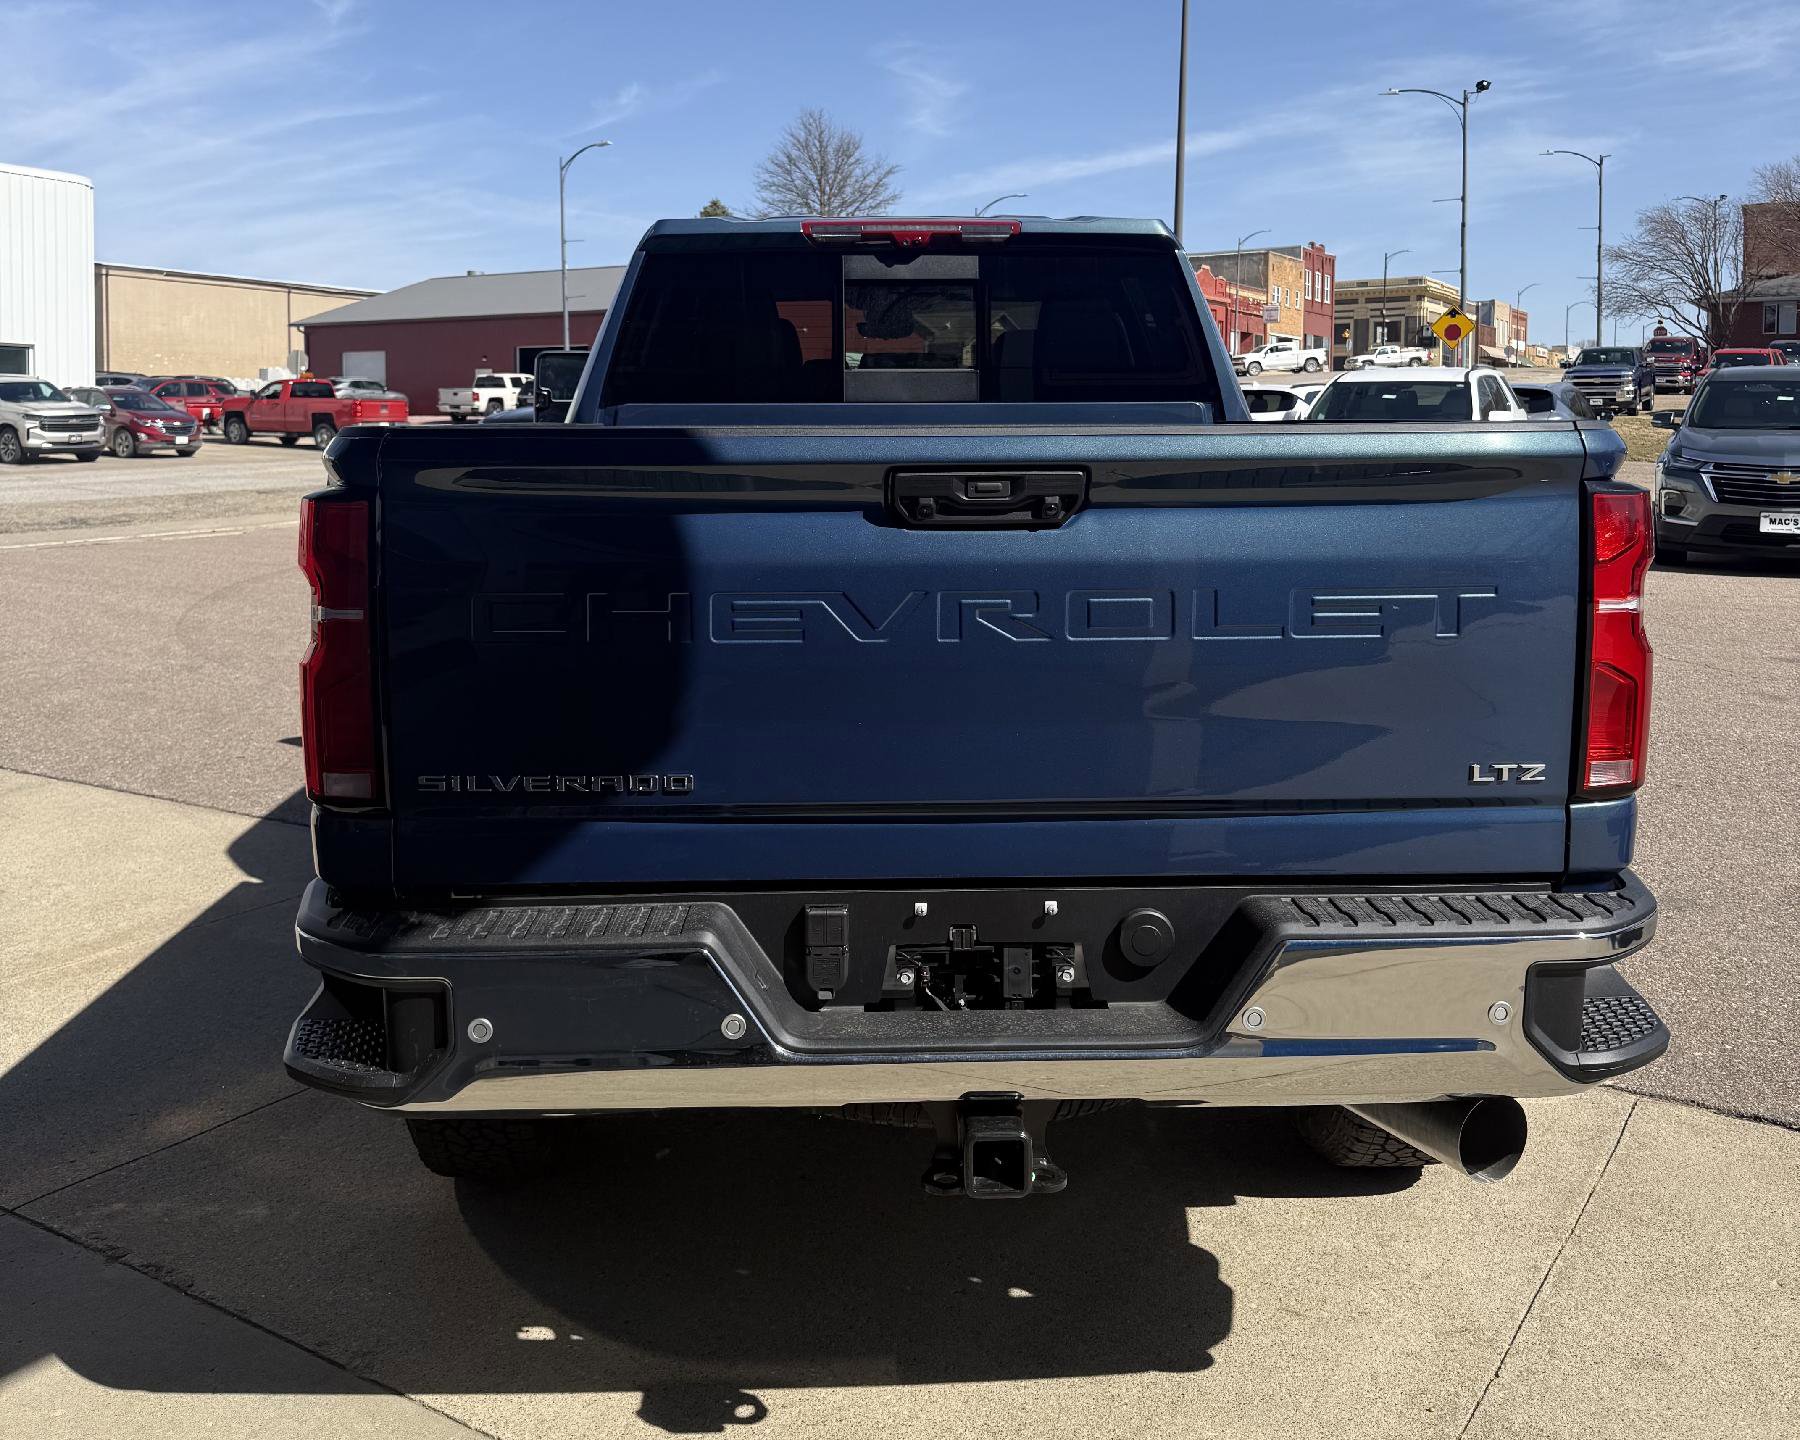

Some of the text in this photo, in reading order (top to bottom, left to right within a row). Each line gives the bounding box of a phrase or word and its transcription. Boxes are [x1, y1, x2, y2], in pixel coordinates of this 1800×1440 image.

[1769, 517, 1799, 526] MAC'S
[470, 586, 1498, 644] CHEVROLET
[1470, 763, 1546, 782] LTZ
[417, 774, 695, 793] SILVERADO
